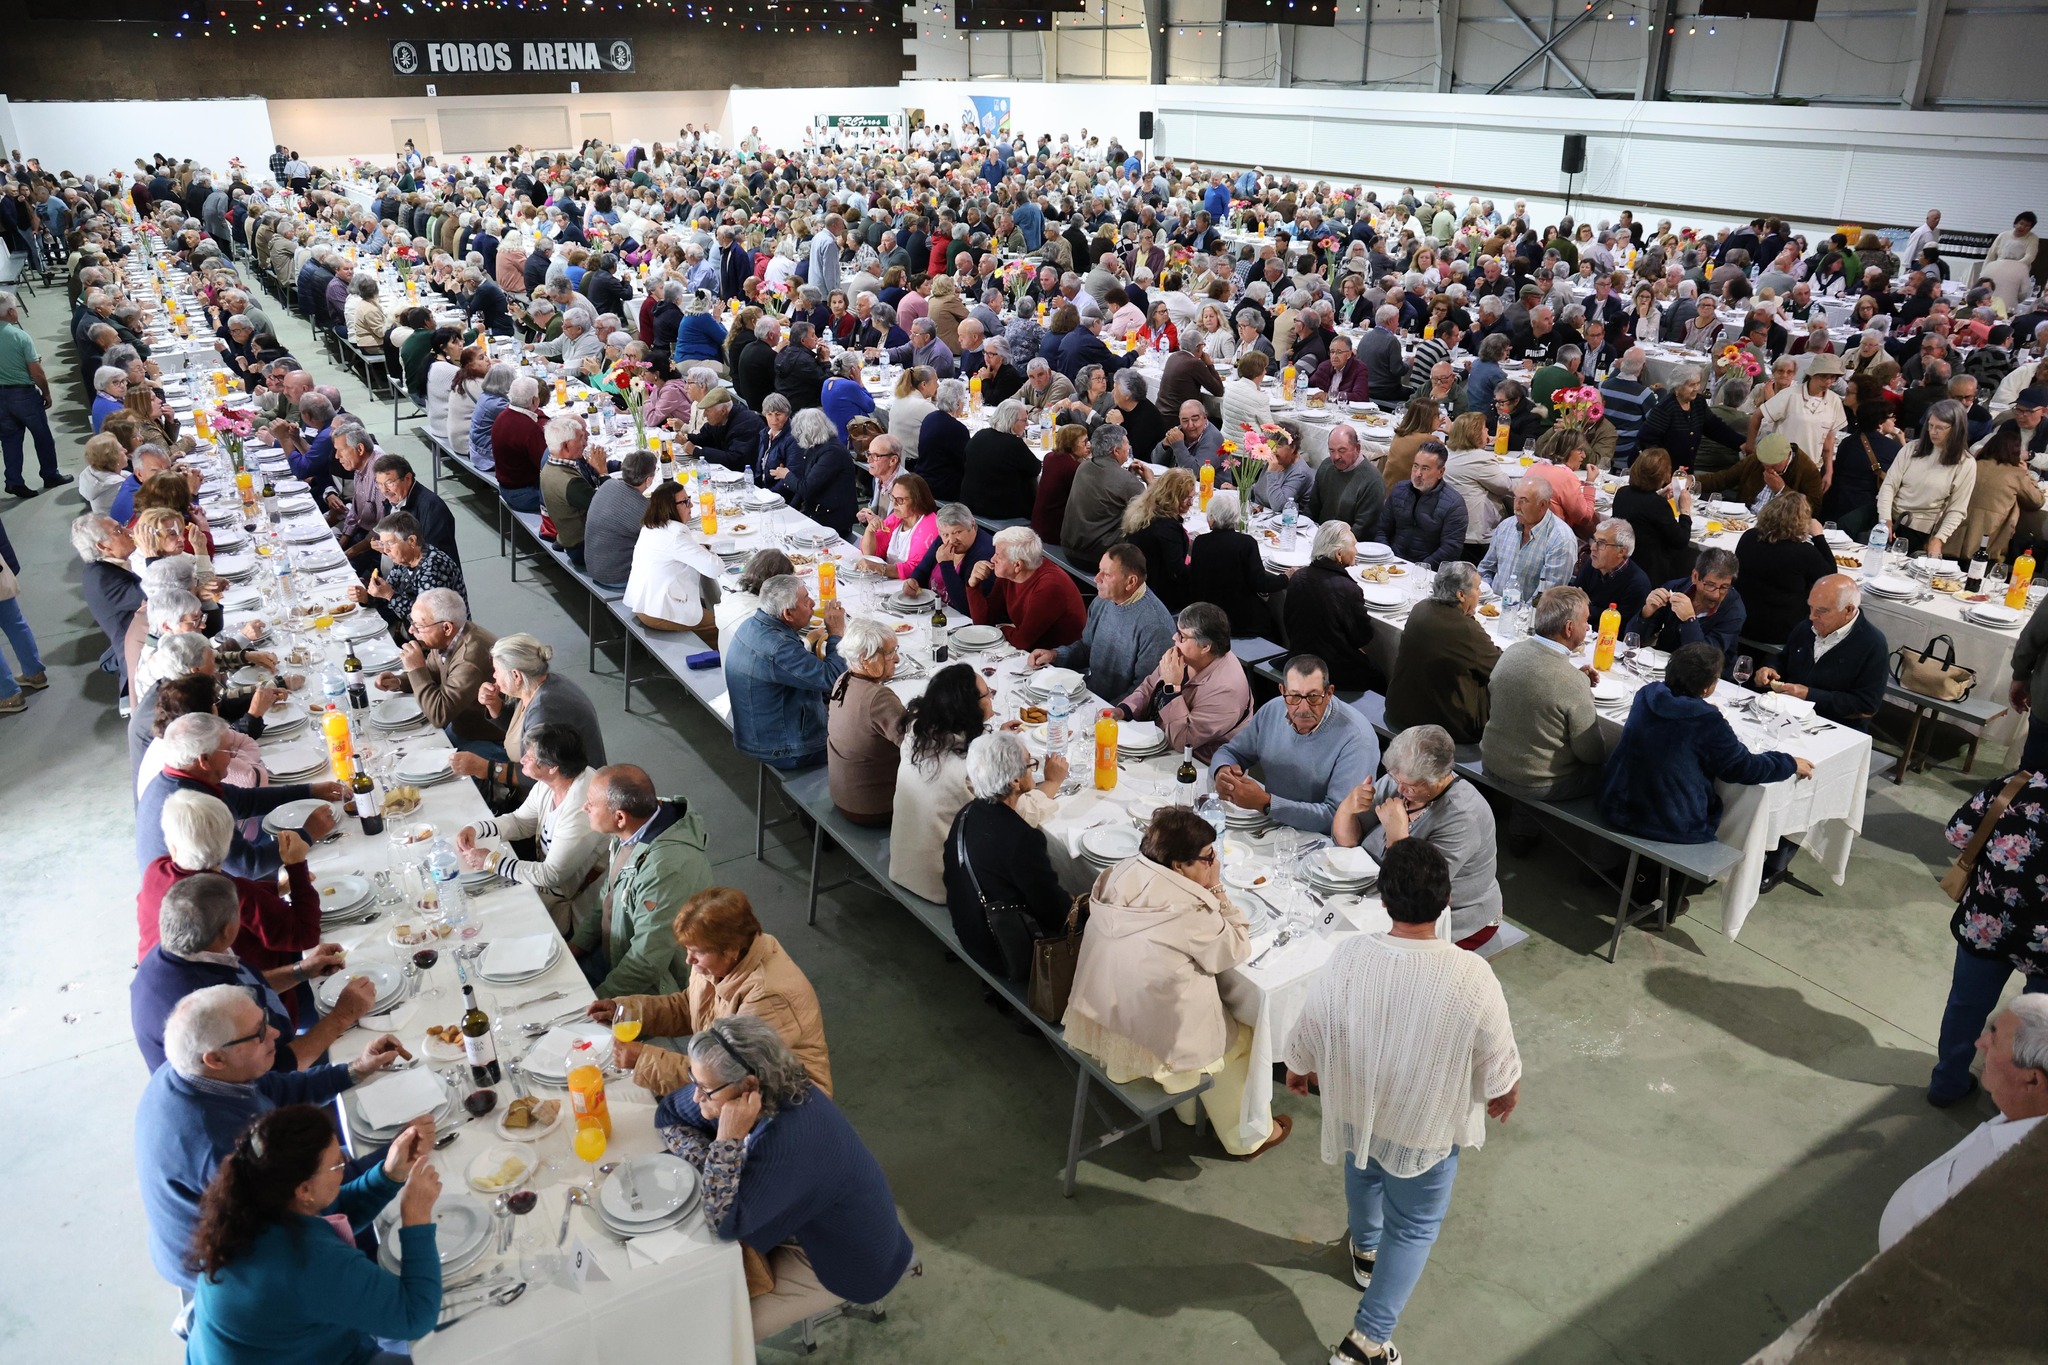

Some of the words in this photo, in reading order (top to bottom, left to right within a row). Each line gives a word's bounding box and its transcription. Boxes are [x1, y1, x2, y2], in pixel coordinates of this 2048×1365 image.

[427, 42, 513, 72] FOROS
[523, 42, 601, 71] ARENA
[1780, 719, 1791, 727] 7
[1324, 912, 1334, 924] 8
[576, 1251, 582, 1268] 9
